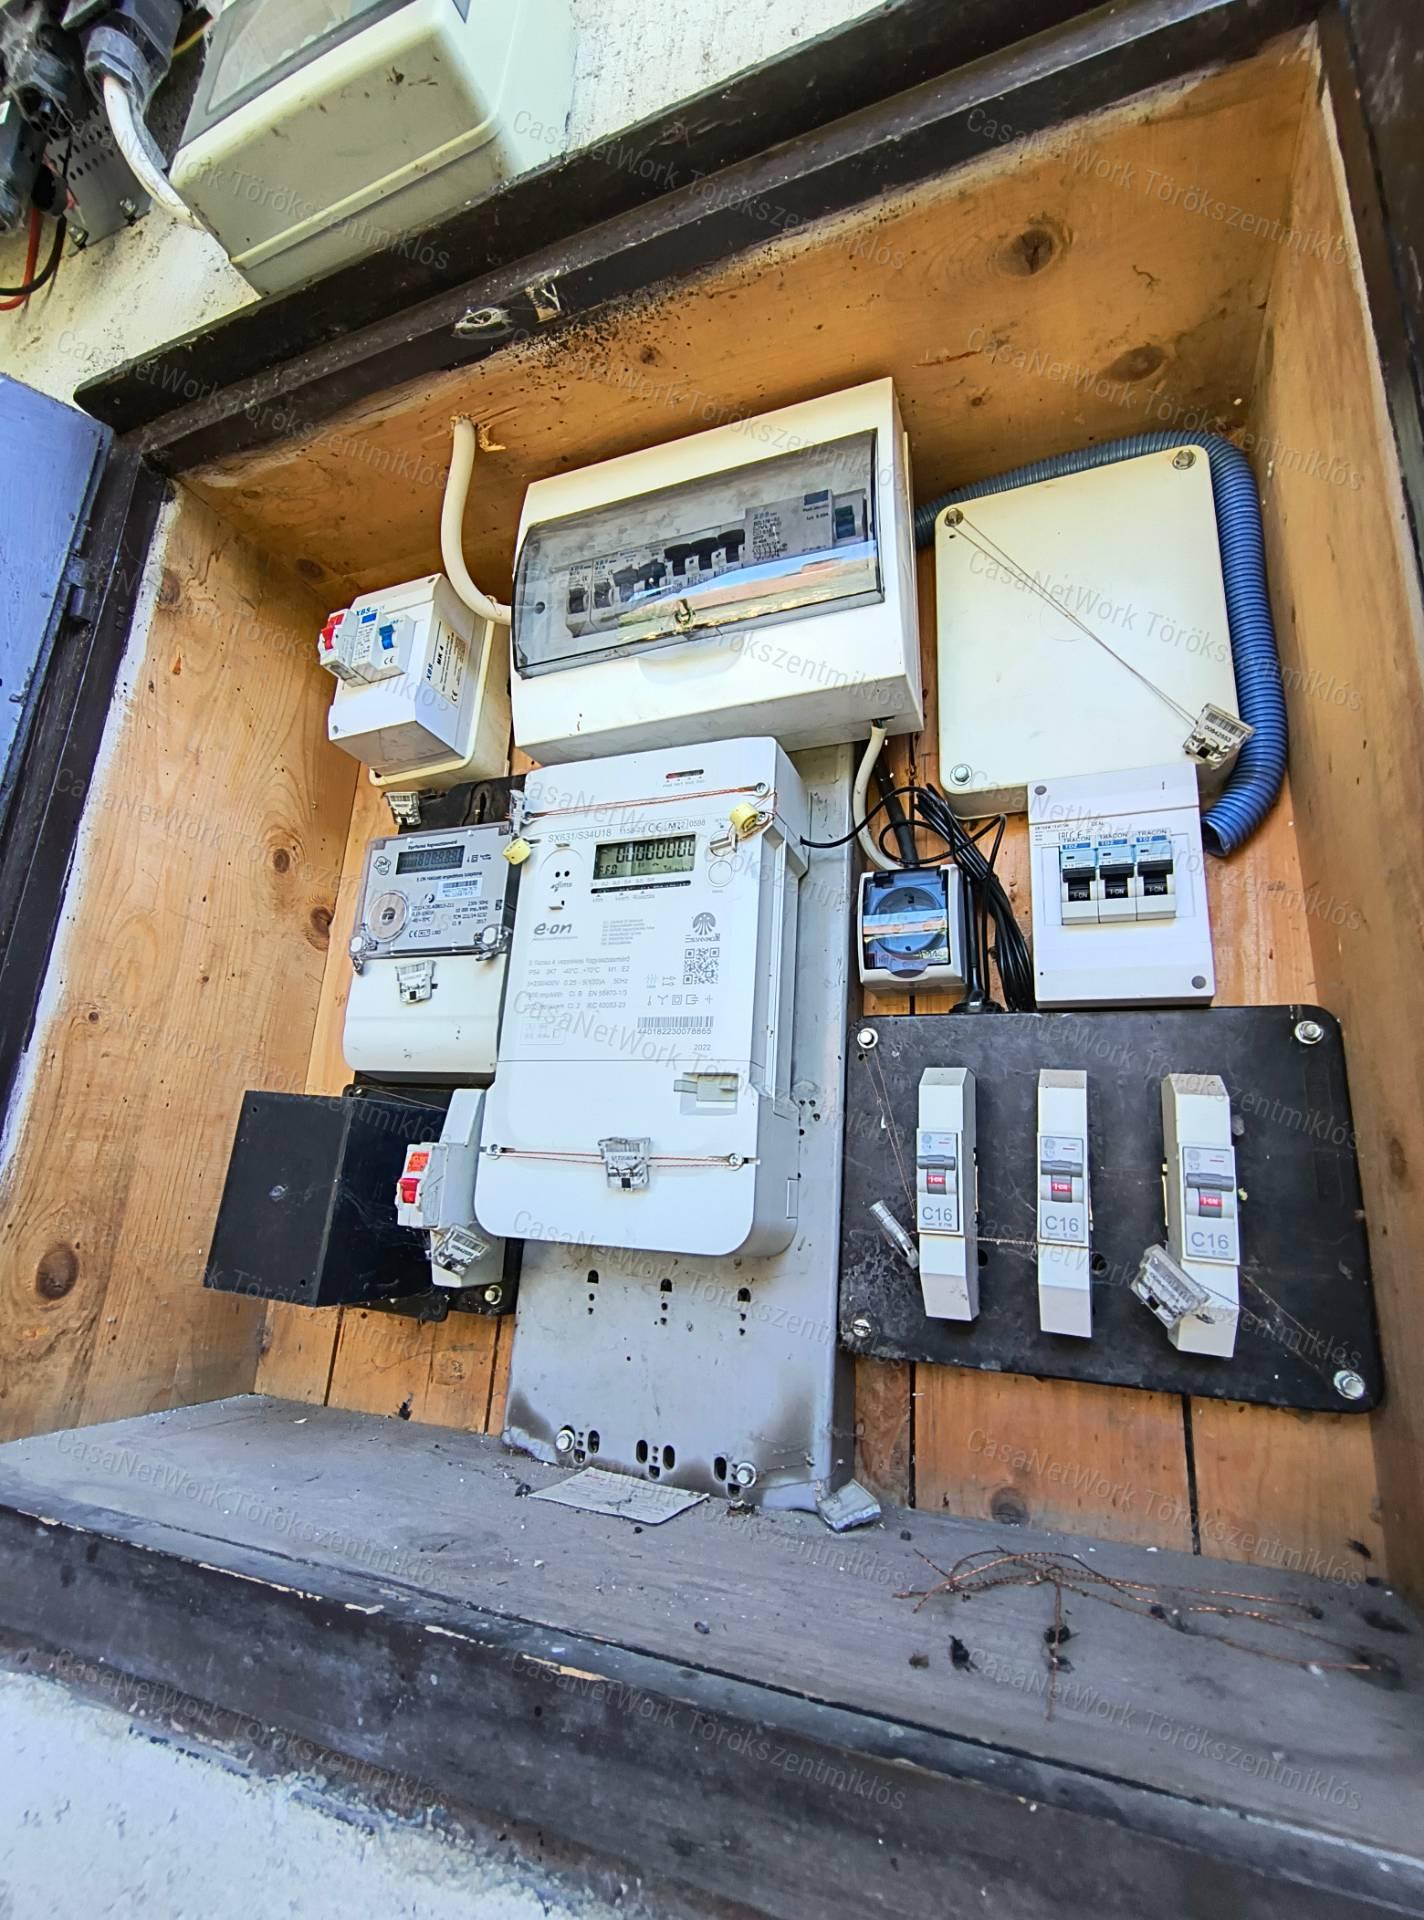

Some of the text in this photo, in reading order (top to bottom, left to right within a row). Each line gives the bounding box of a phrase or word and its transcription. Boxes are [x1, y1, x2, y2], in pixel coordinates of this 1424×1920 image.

[1100, 832, 1128, 840] TRACON
[1137, 829, 1167, 837] TRACON
[1062, 836, 1091, 844] TRACON
[921, 1206, 953, 1223] C16
[1045, 1215, 1079, 1232] C16
[1190, 1231, 1229, 1250] C16
